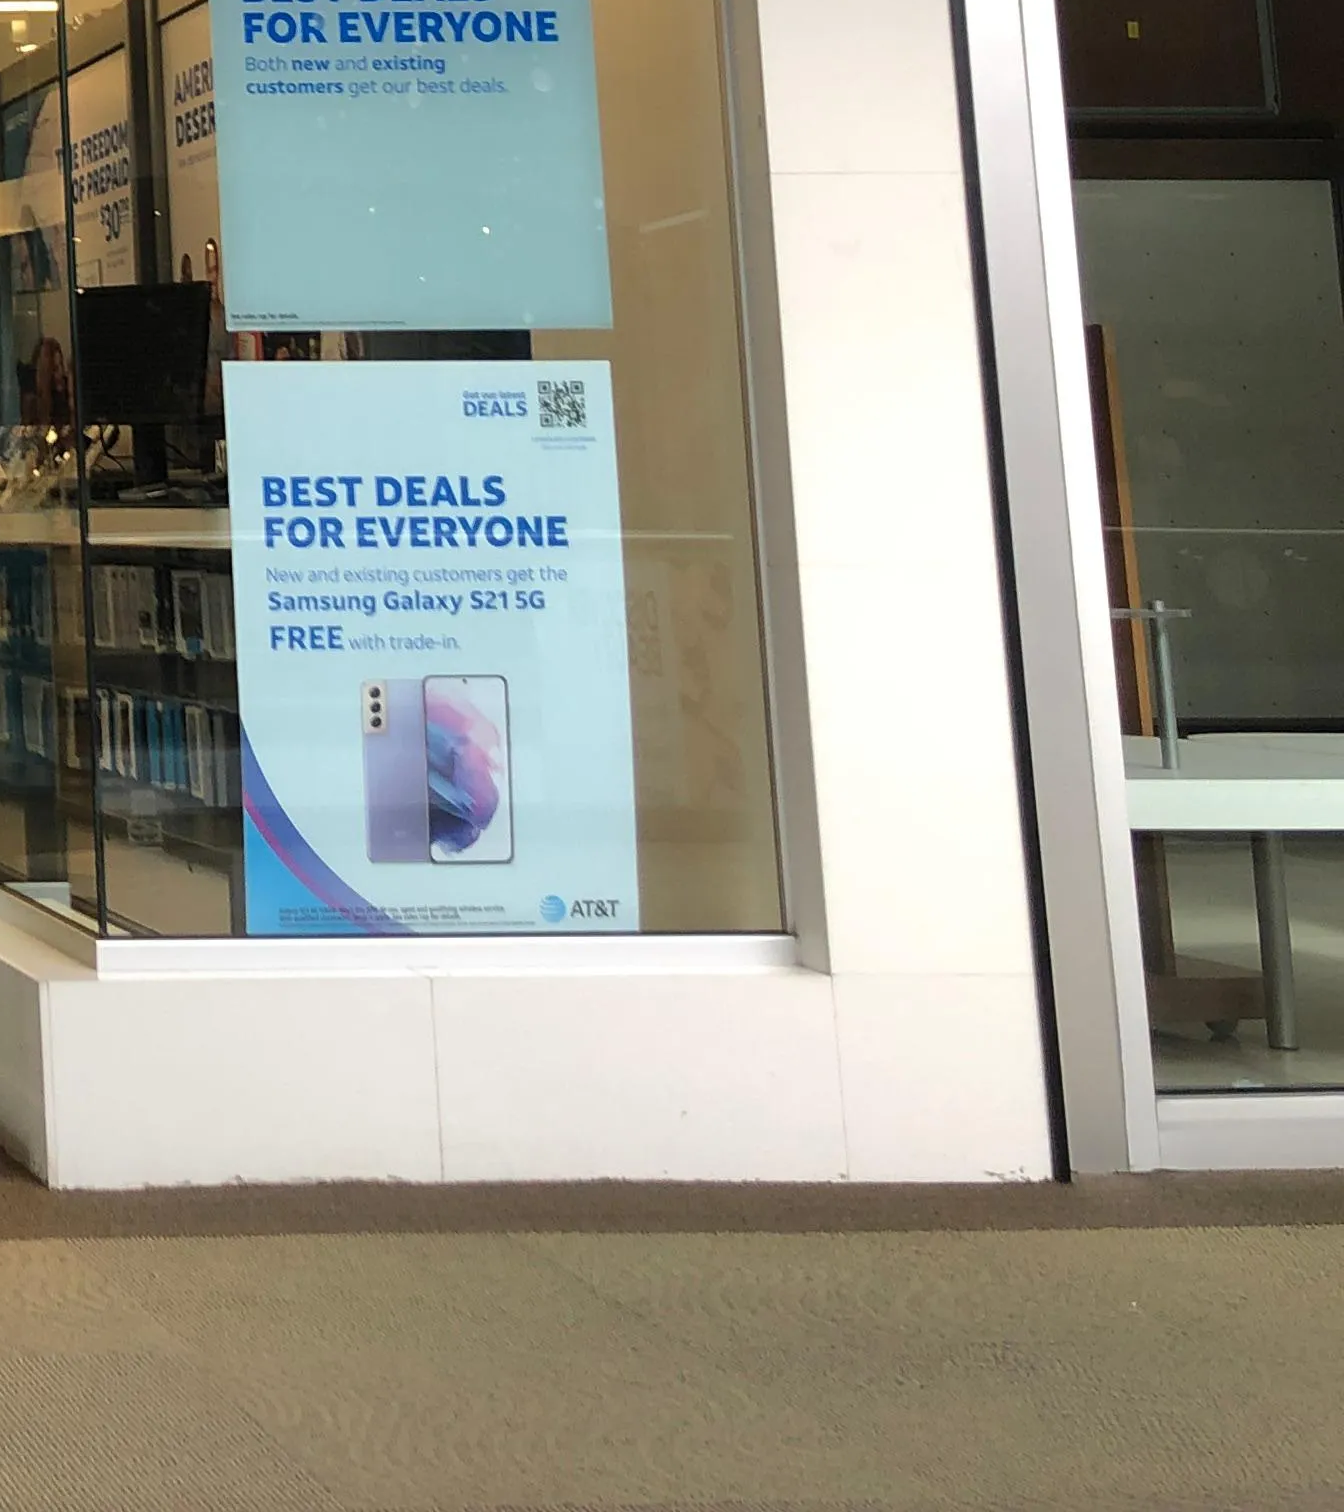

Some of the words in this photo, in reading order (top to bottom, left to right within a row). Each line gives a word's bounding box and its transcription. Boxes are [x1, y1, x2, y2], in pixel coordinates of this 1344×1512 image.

[243, 11, 328, 43] FOR
[339, 11, 559, 42] EVERYONE
[245, 57, 287, 72] Both
[292, 59, 330, 71] new
[334, 57, 368, 71] and
[372, 56, 446, 74] existing
[174, 58, 213, 106] AMERI
[247, 80, 344, 94] customers
[348, 80, 377, 97] get
[382, 81, 411, 94] our
[416, 79, 455, 94] best
[459, 79, 508, 94] deals.
[176, 101, 215, 147] DESER
[463, 401, 528, 417] DEALS
[262, 476, 363, 507] BEST
[375, 475, 506, 507] DEALS
[263, 516, 345, 548] FOR
[356, 516, 569, 548] EVERYONE
[266, 568, 303, 583] New
[308, 567, 339, 583] and
[343, 567, 409, 586] existing
[413, 568, 502, 583] customers
[506, 568, 534, 586] get
[539, 567, 567, 582] the
[268, 592, 376, 615] Samsung
[384, 590, 462, 615] Galaxy
[270, 625, 344, 651] FREE
[349, 634, 385, 651] with
[570, 899, 620, 918] AT&T
